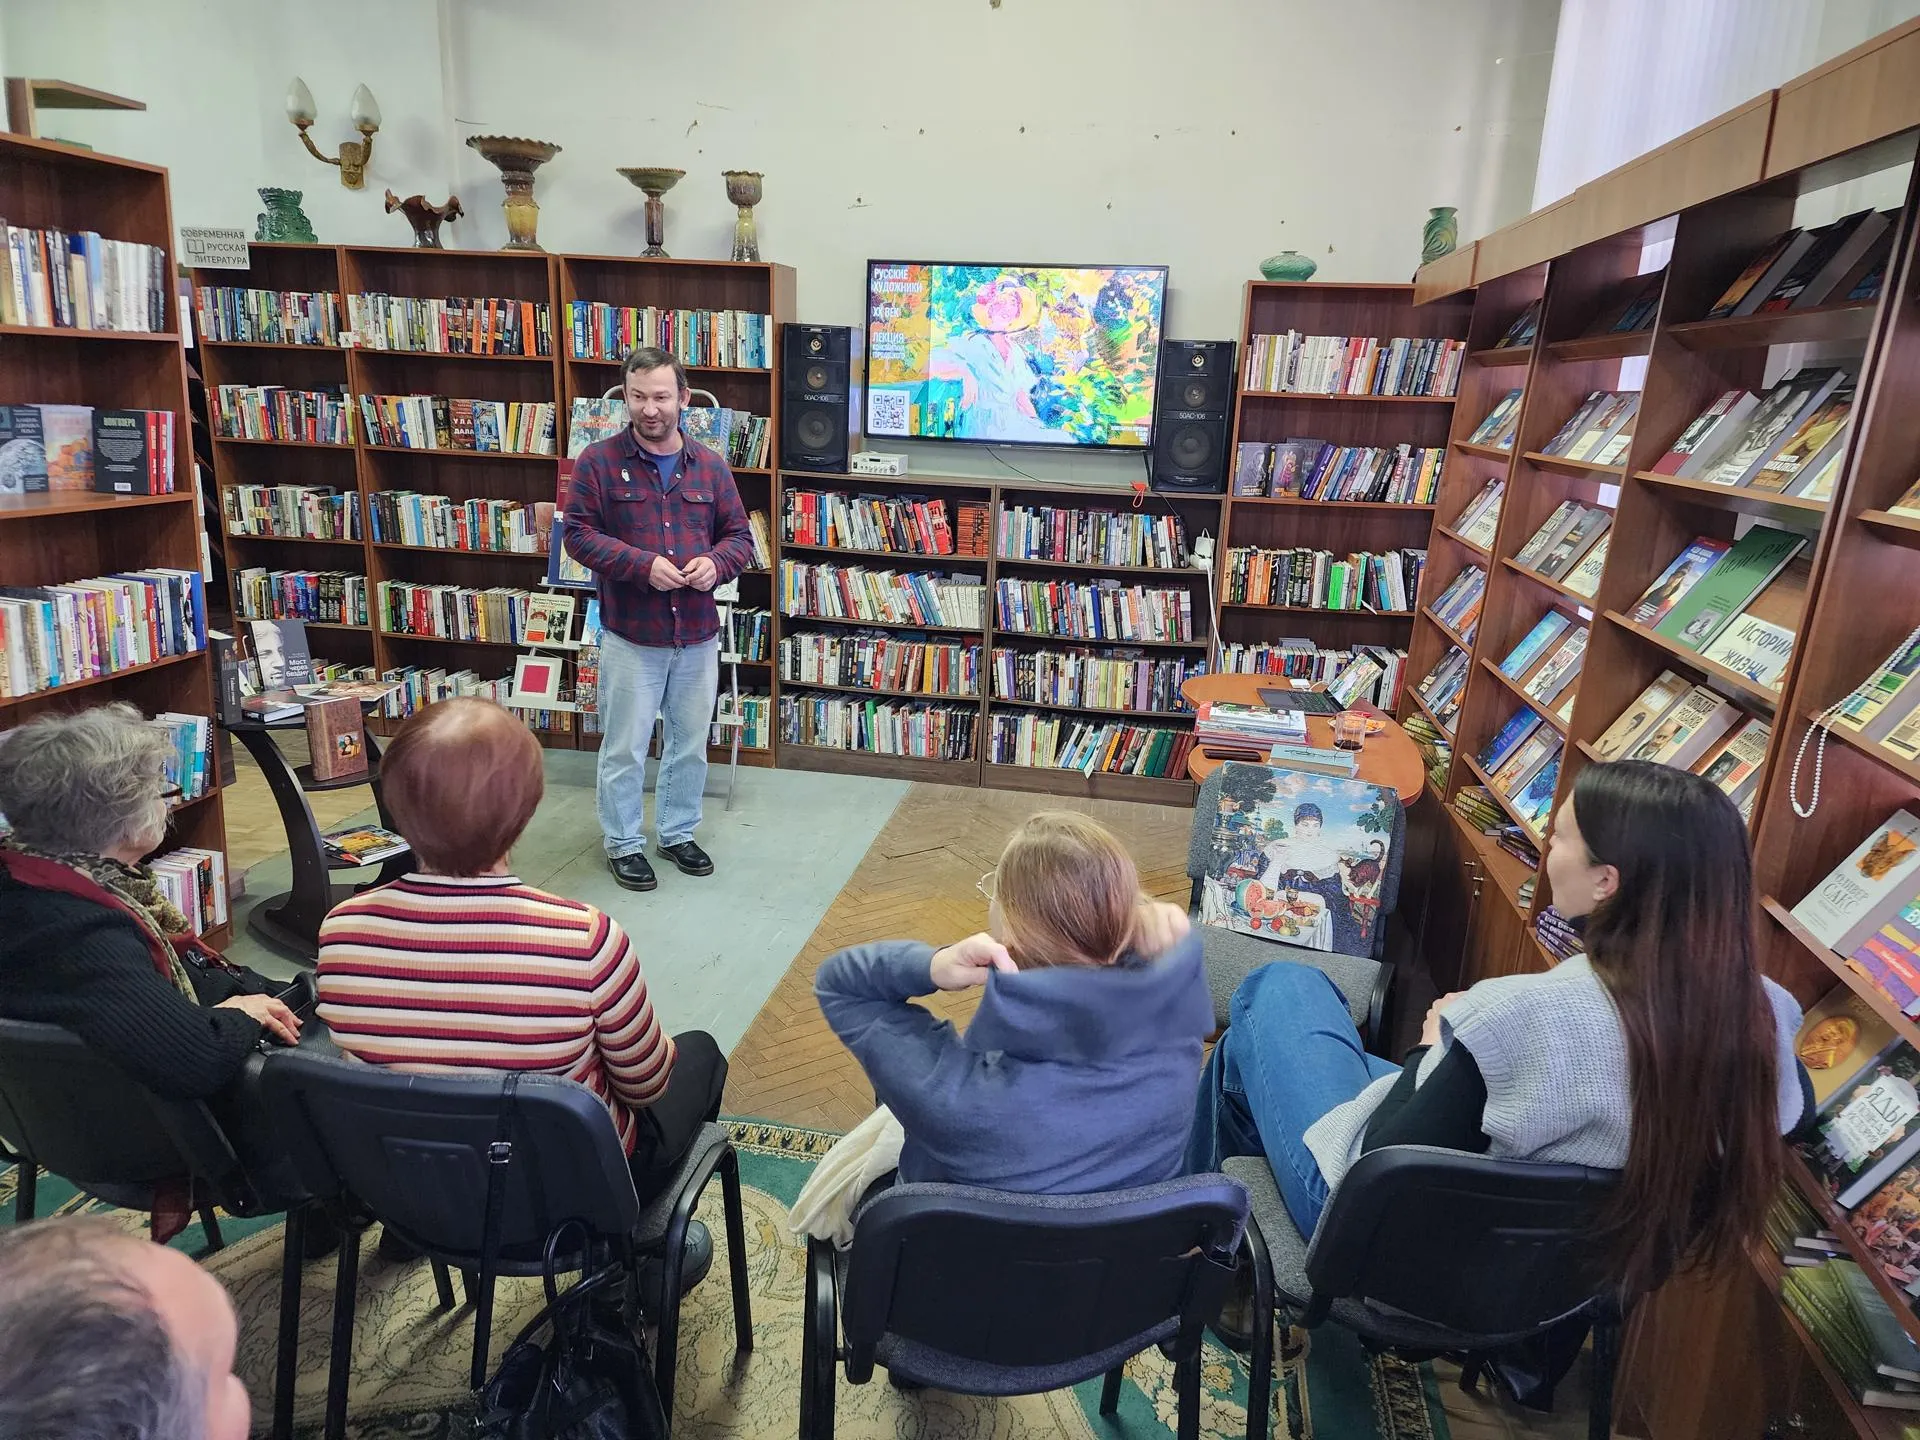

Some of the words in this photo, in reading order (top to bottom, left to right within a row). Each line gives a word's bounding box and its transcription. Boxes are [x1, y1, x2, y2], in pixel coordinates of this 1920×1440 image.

[181, 228, 245, 240] СОВРЕМЕННАЯ
[206, 243, 247, 252] РУССКАЯ
[194, 255, 248, 265] ЛИТЕРАТУРА
[874, 268, 908, 280] РУССКИЕ
[872, 281, 922, 293] ХУДОЖНИКИ
[884, 306, 900, 318] ВЕК
[872, 332, 905, 343] ЛЕКЦИЯ
[1719, 649, 1768, 678] ЖИЗНИ
[1823, 883, 1859, 914] САКС
[1866, 1086, 1908, 1127] ЯДЫ
